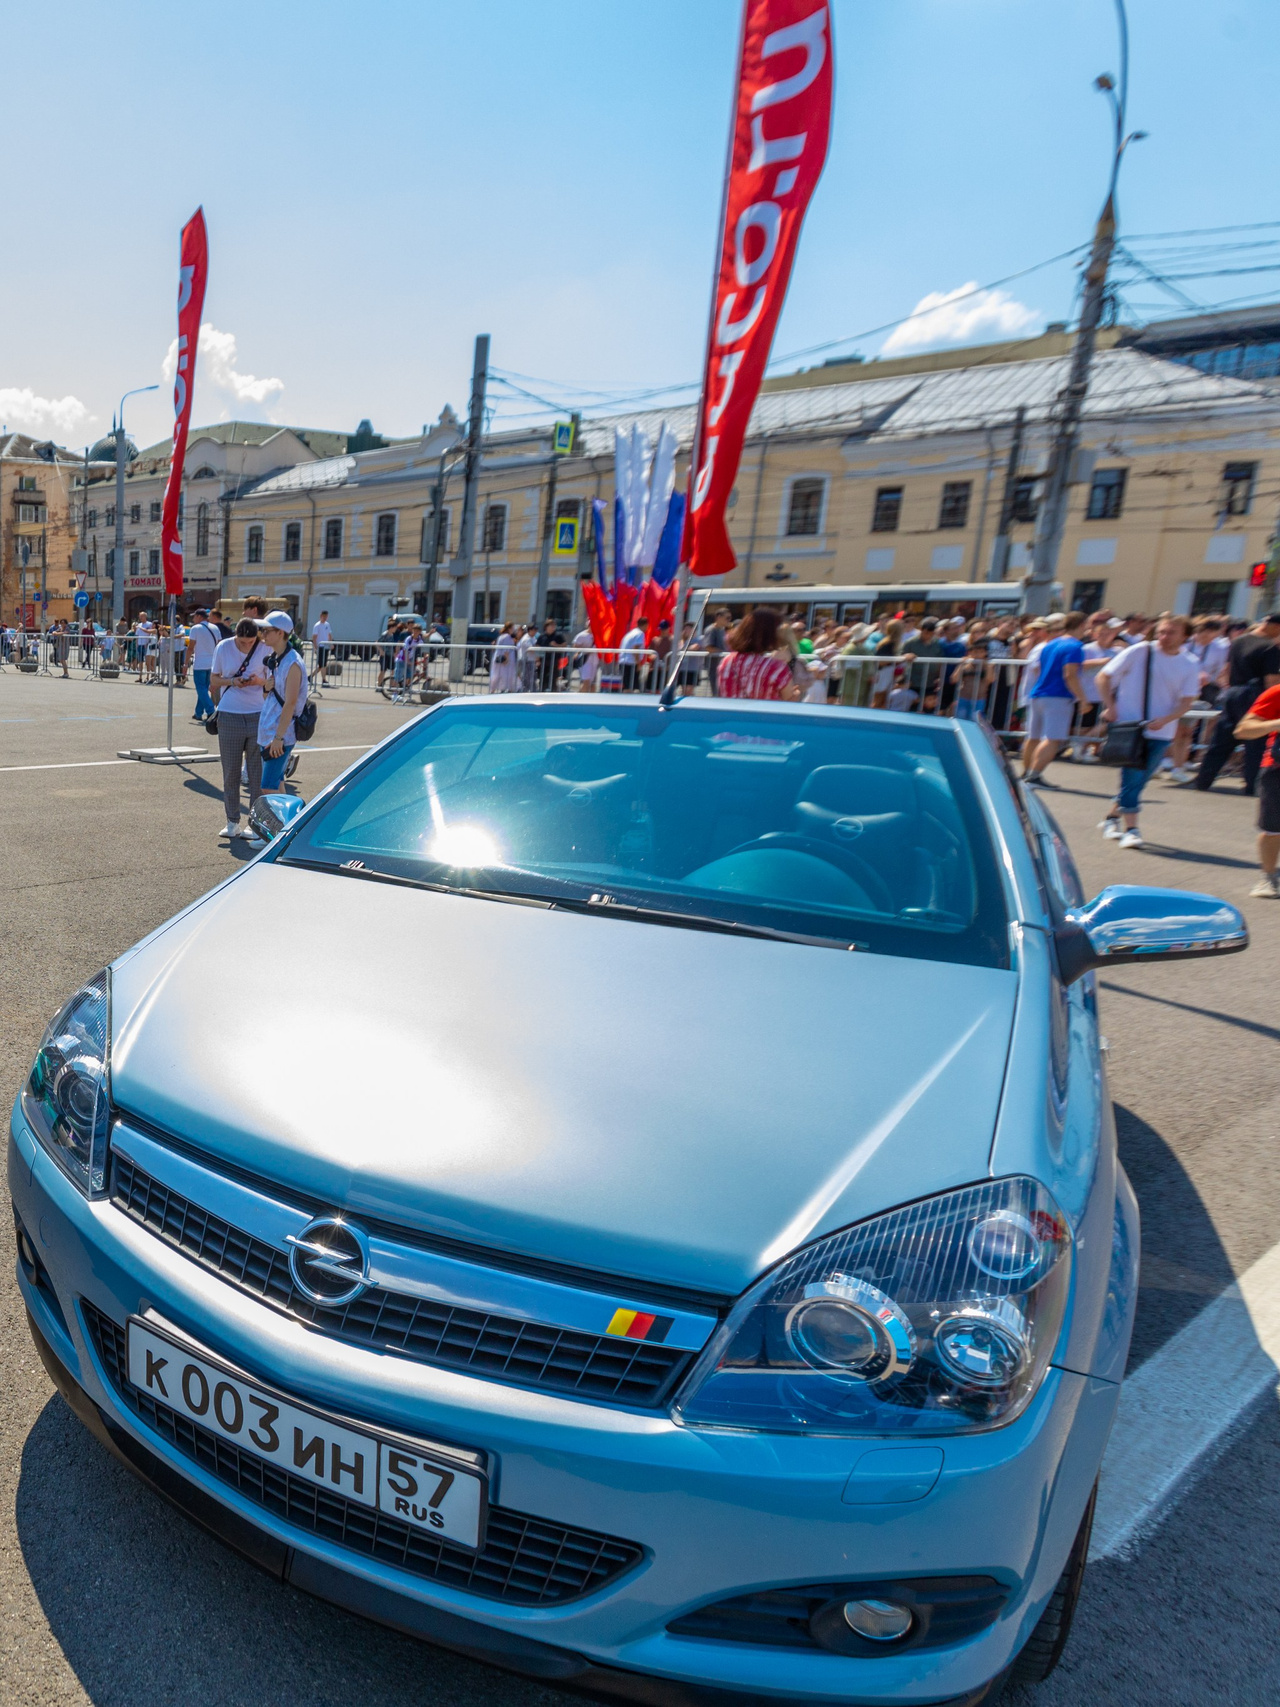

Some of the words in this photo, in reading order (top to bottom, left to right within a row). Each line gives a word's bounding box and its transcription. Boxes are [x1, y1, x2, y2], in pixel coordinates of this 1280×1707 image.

[130, 577, 161, 586] TOMATO
[144, 1348, 169, 1399] К
[181, 1364, 280, 1453] 003
[293, 1426, 365, 1495] ИН
[387, 1450, 455, 1509] 57
[394, 1496, 445, 1530] RUS
